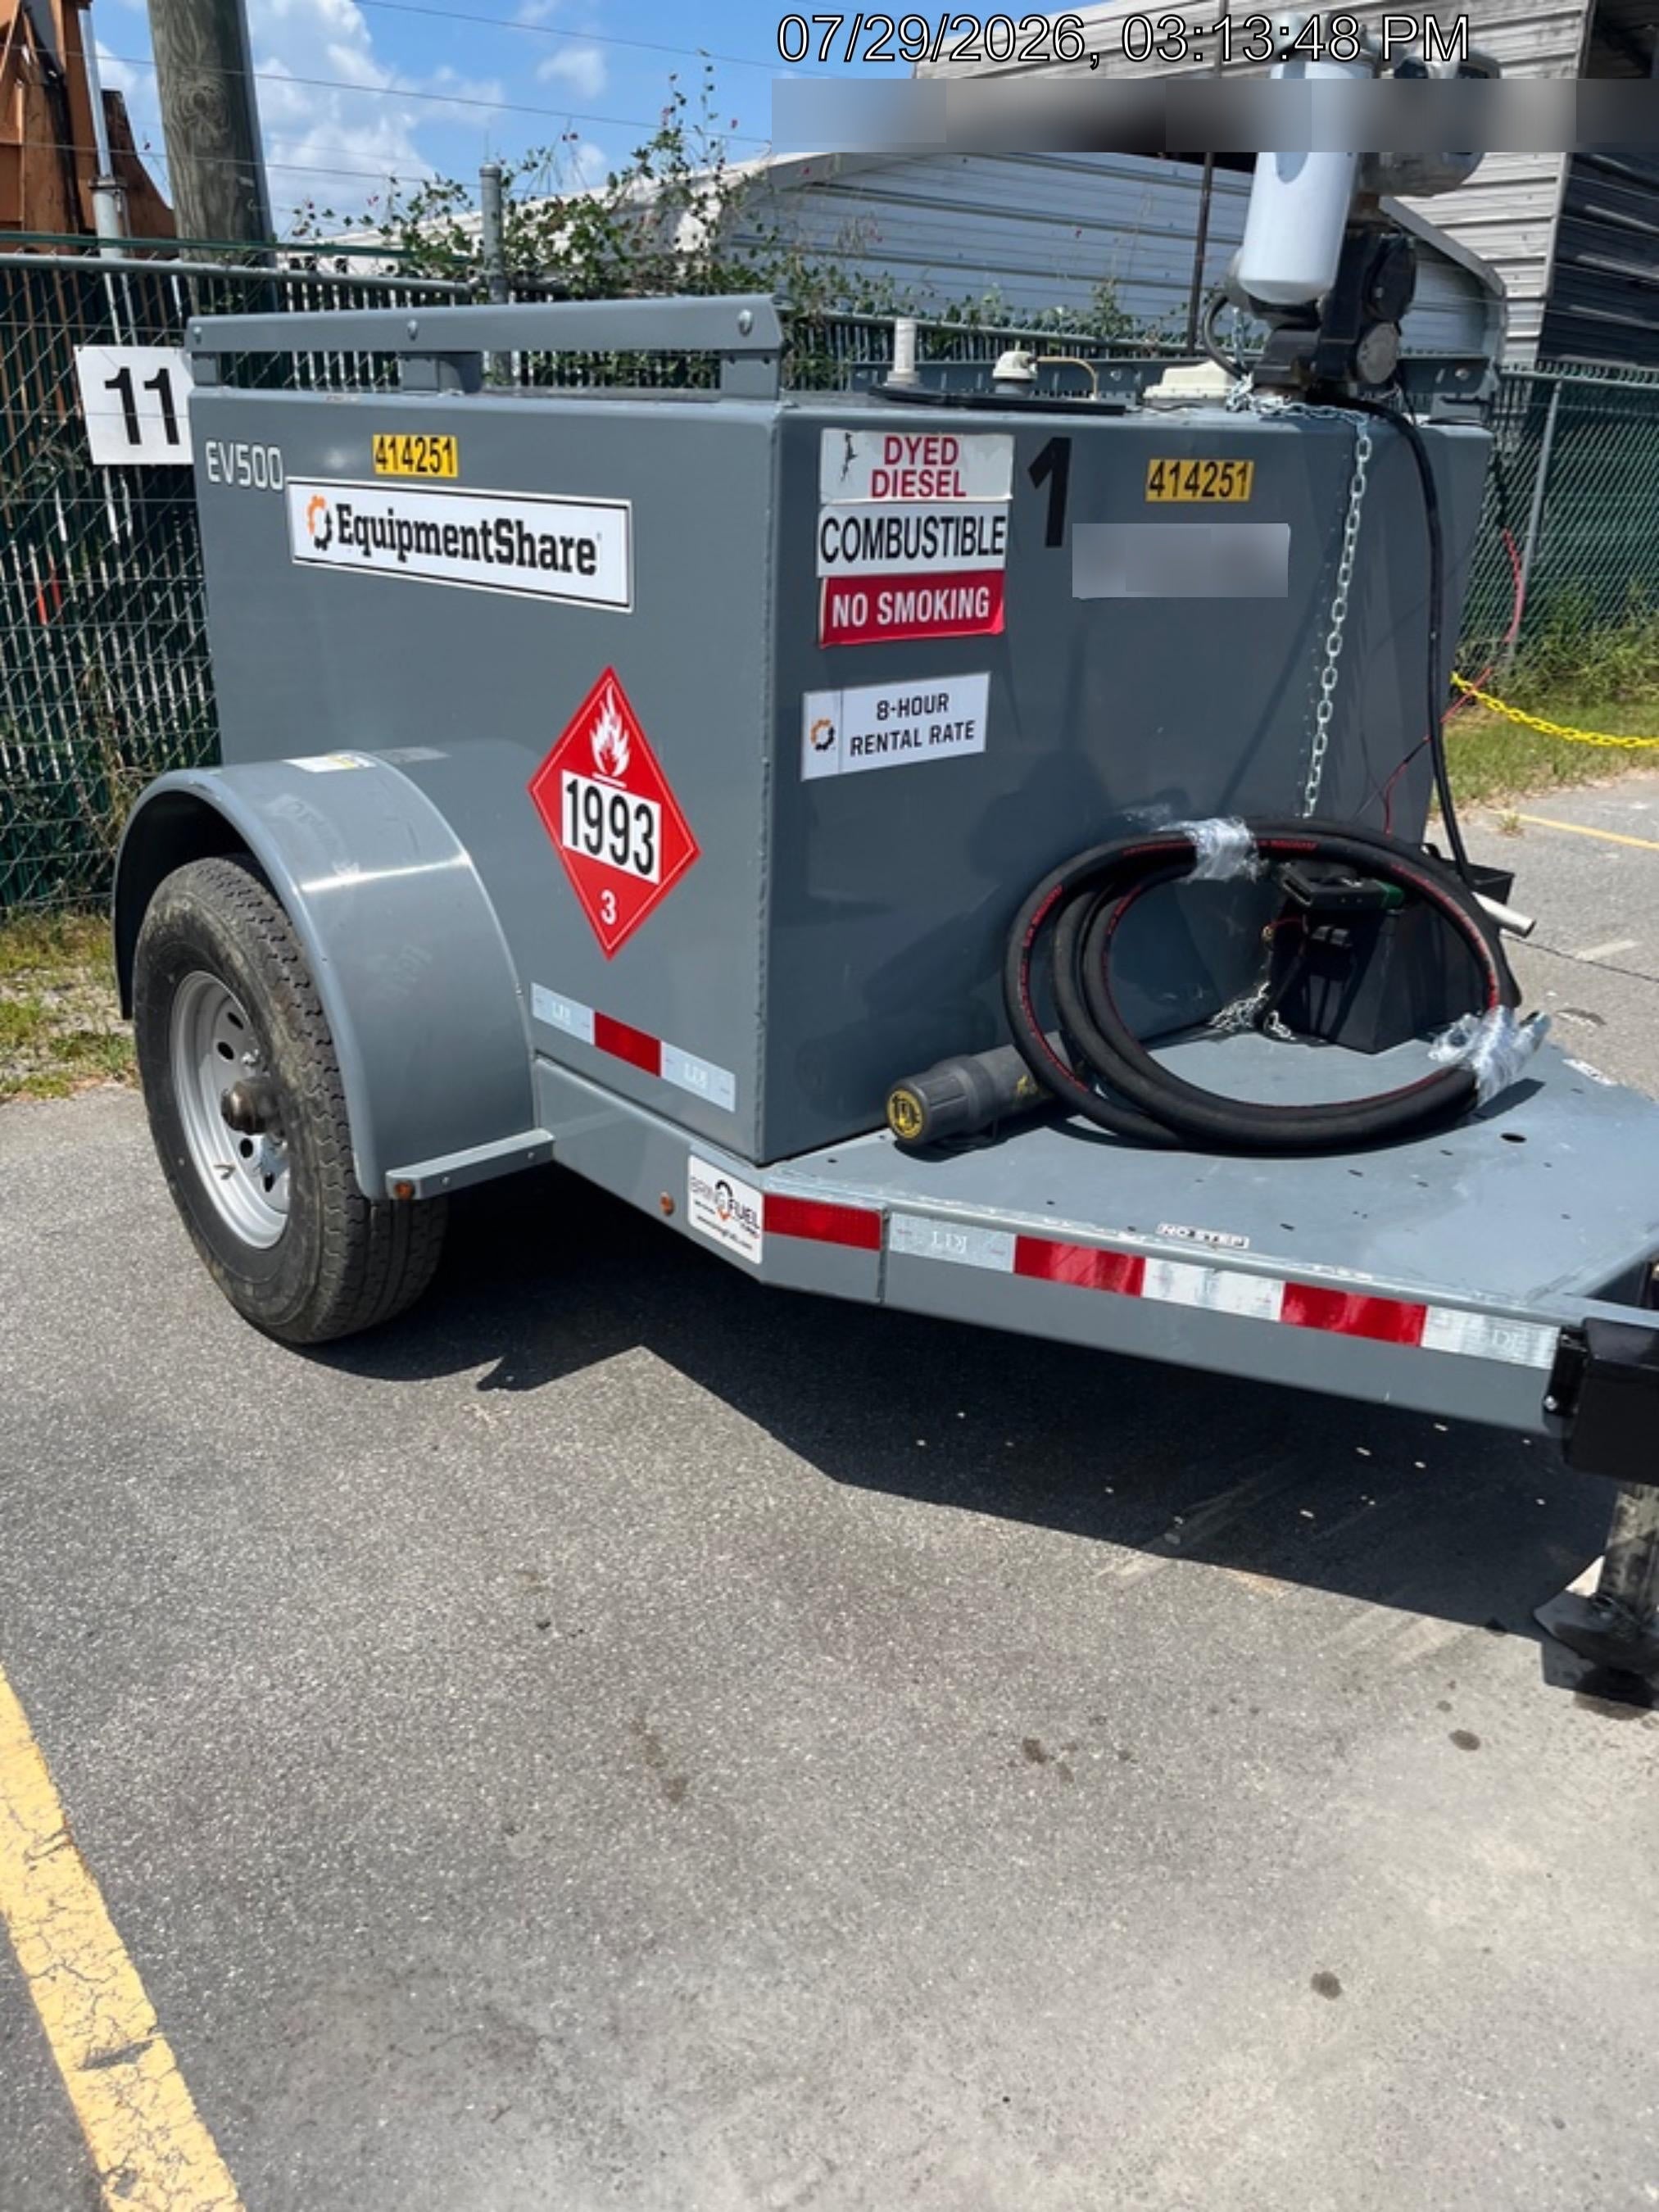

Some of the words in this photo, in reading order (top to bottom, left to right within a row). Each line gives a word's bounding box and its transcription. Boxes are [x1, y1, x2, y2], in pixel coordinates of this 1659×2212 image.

[104, 368, 180, 445] 11
[205, 441, 284, 490] EV500
[374, 436, 456, 473] 414251
[884, 436, 959, 465] DYED
[871, 469, 967, 499] DIESEL
[1027, 437, 1072, 548] 1
[1149, 461, 1250, 497] 414251
[334, 503, 597, 577] EquipmentShare
[821, 516, 1007, 563] COMBUSTIBLE
[832, 594, 868, 628] NO
[877, 587, 990, 625] SMOKING
[876, 693, 950, 721] 8-HOUR
[850, 734, 923, 757] RENTAL
[929, 721, 976, 746] RATE
[565, 779, 655, 876] 1993
[601, 889, 618, 925] 3
